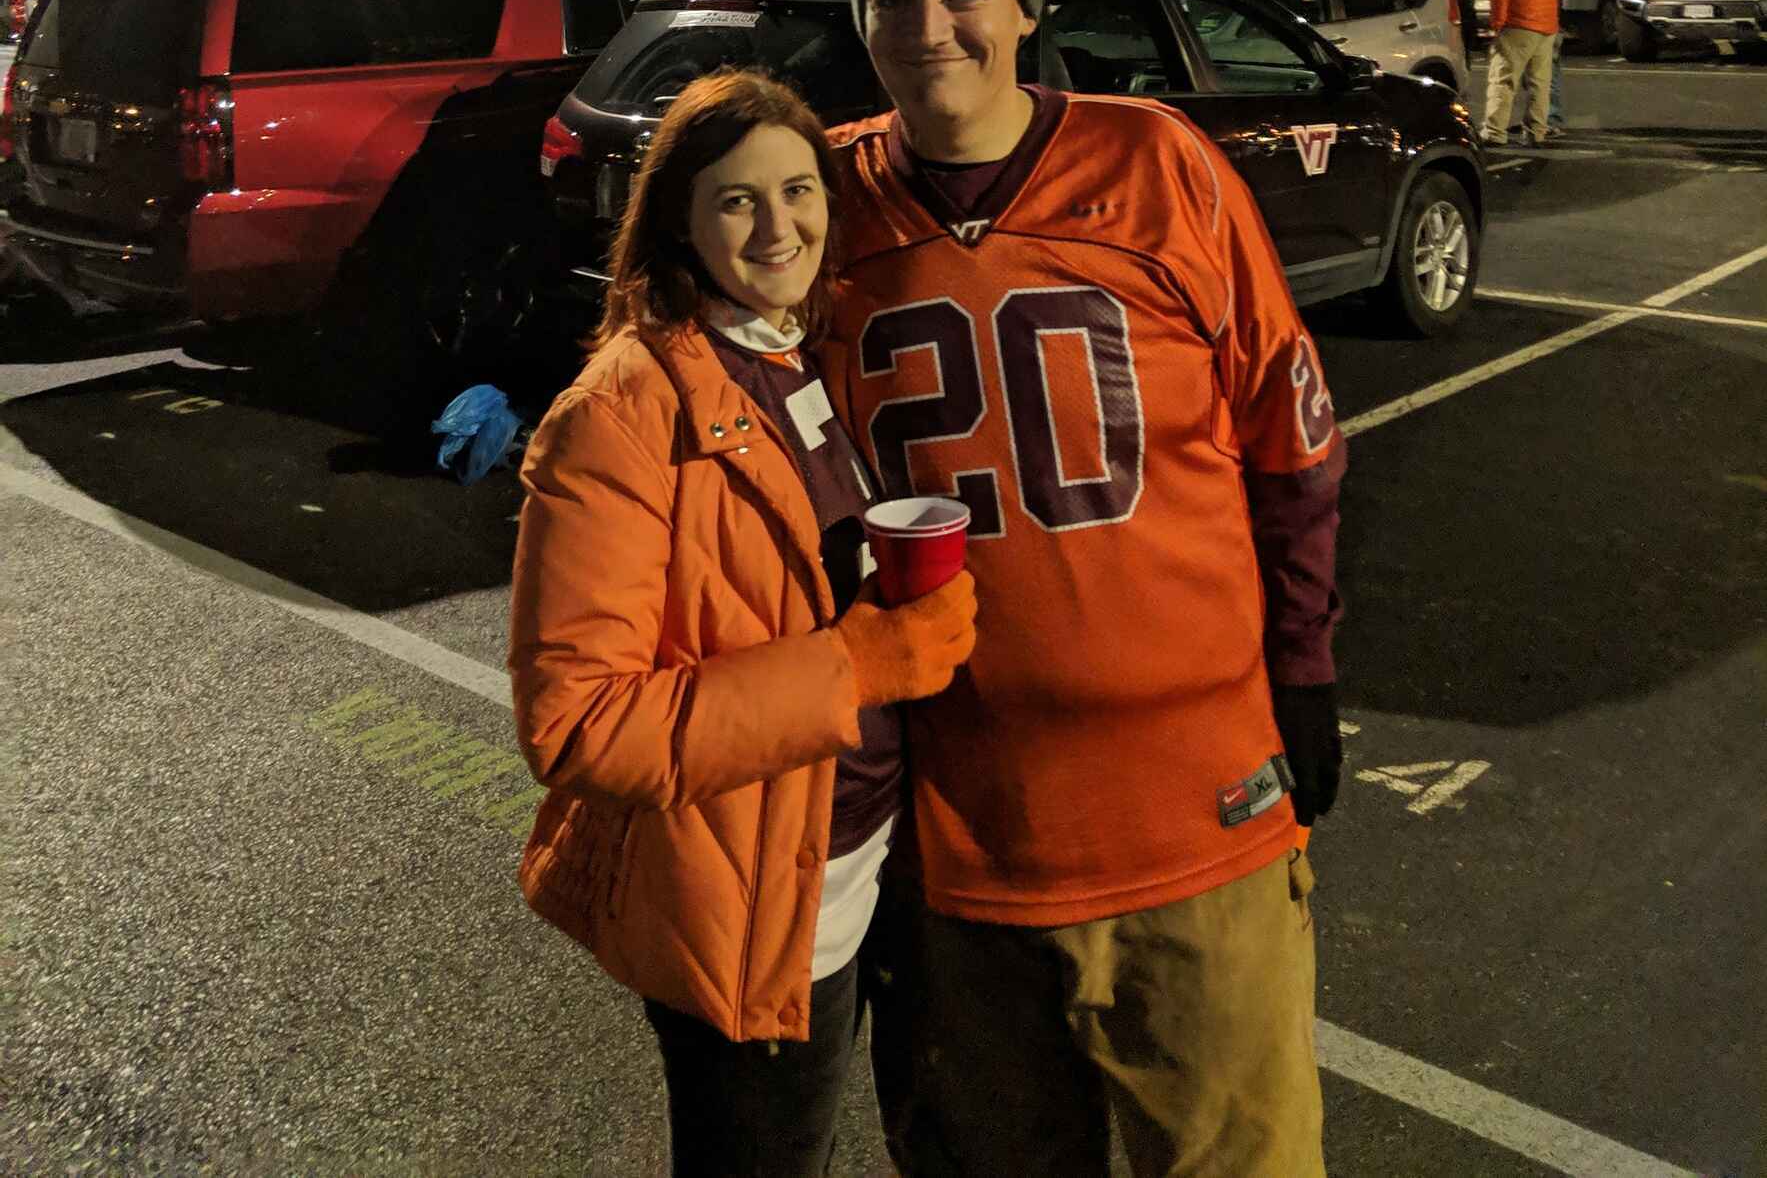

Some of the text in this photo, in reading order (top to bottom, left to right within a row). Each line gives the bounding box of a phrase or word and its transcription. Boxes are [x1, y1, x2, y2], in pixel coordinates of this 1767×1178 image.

[1291, 123, 1337, 176] VT
[952, 219, 989, 239] VT
[859, 285, 1145, 539] 20
[1254, 774, 1273, 796] XL
